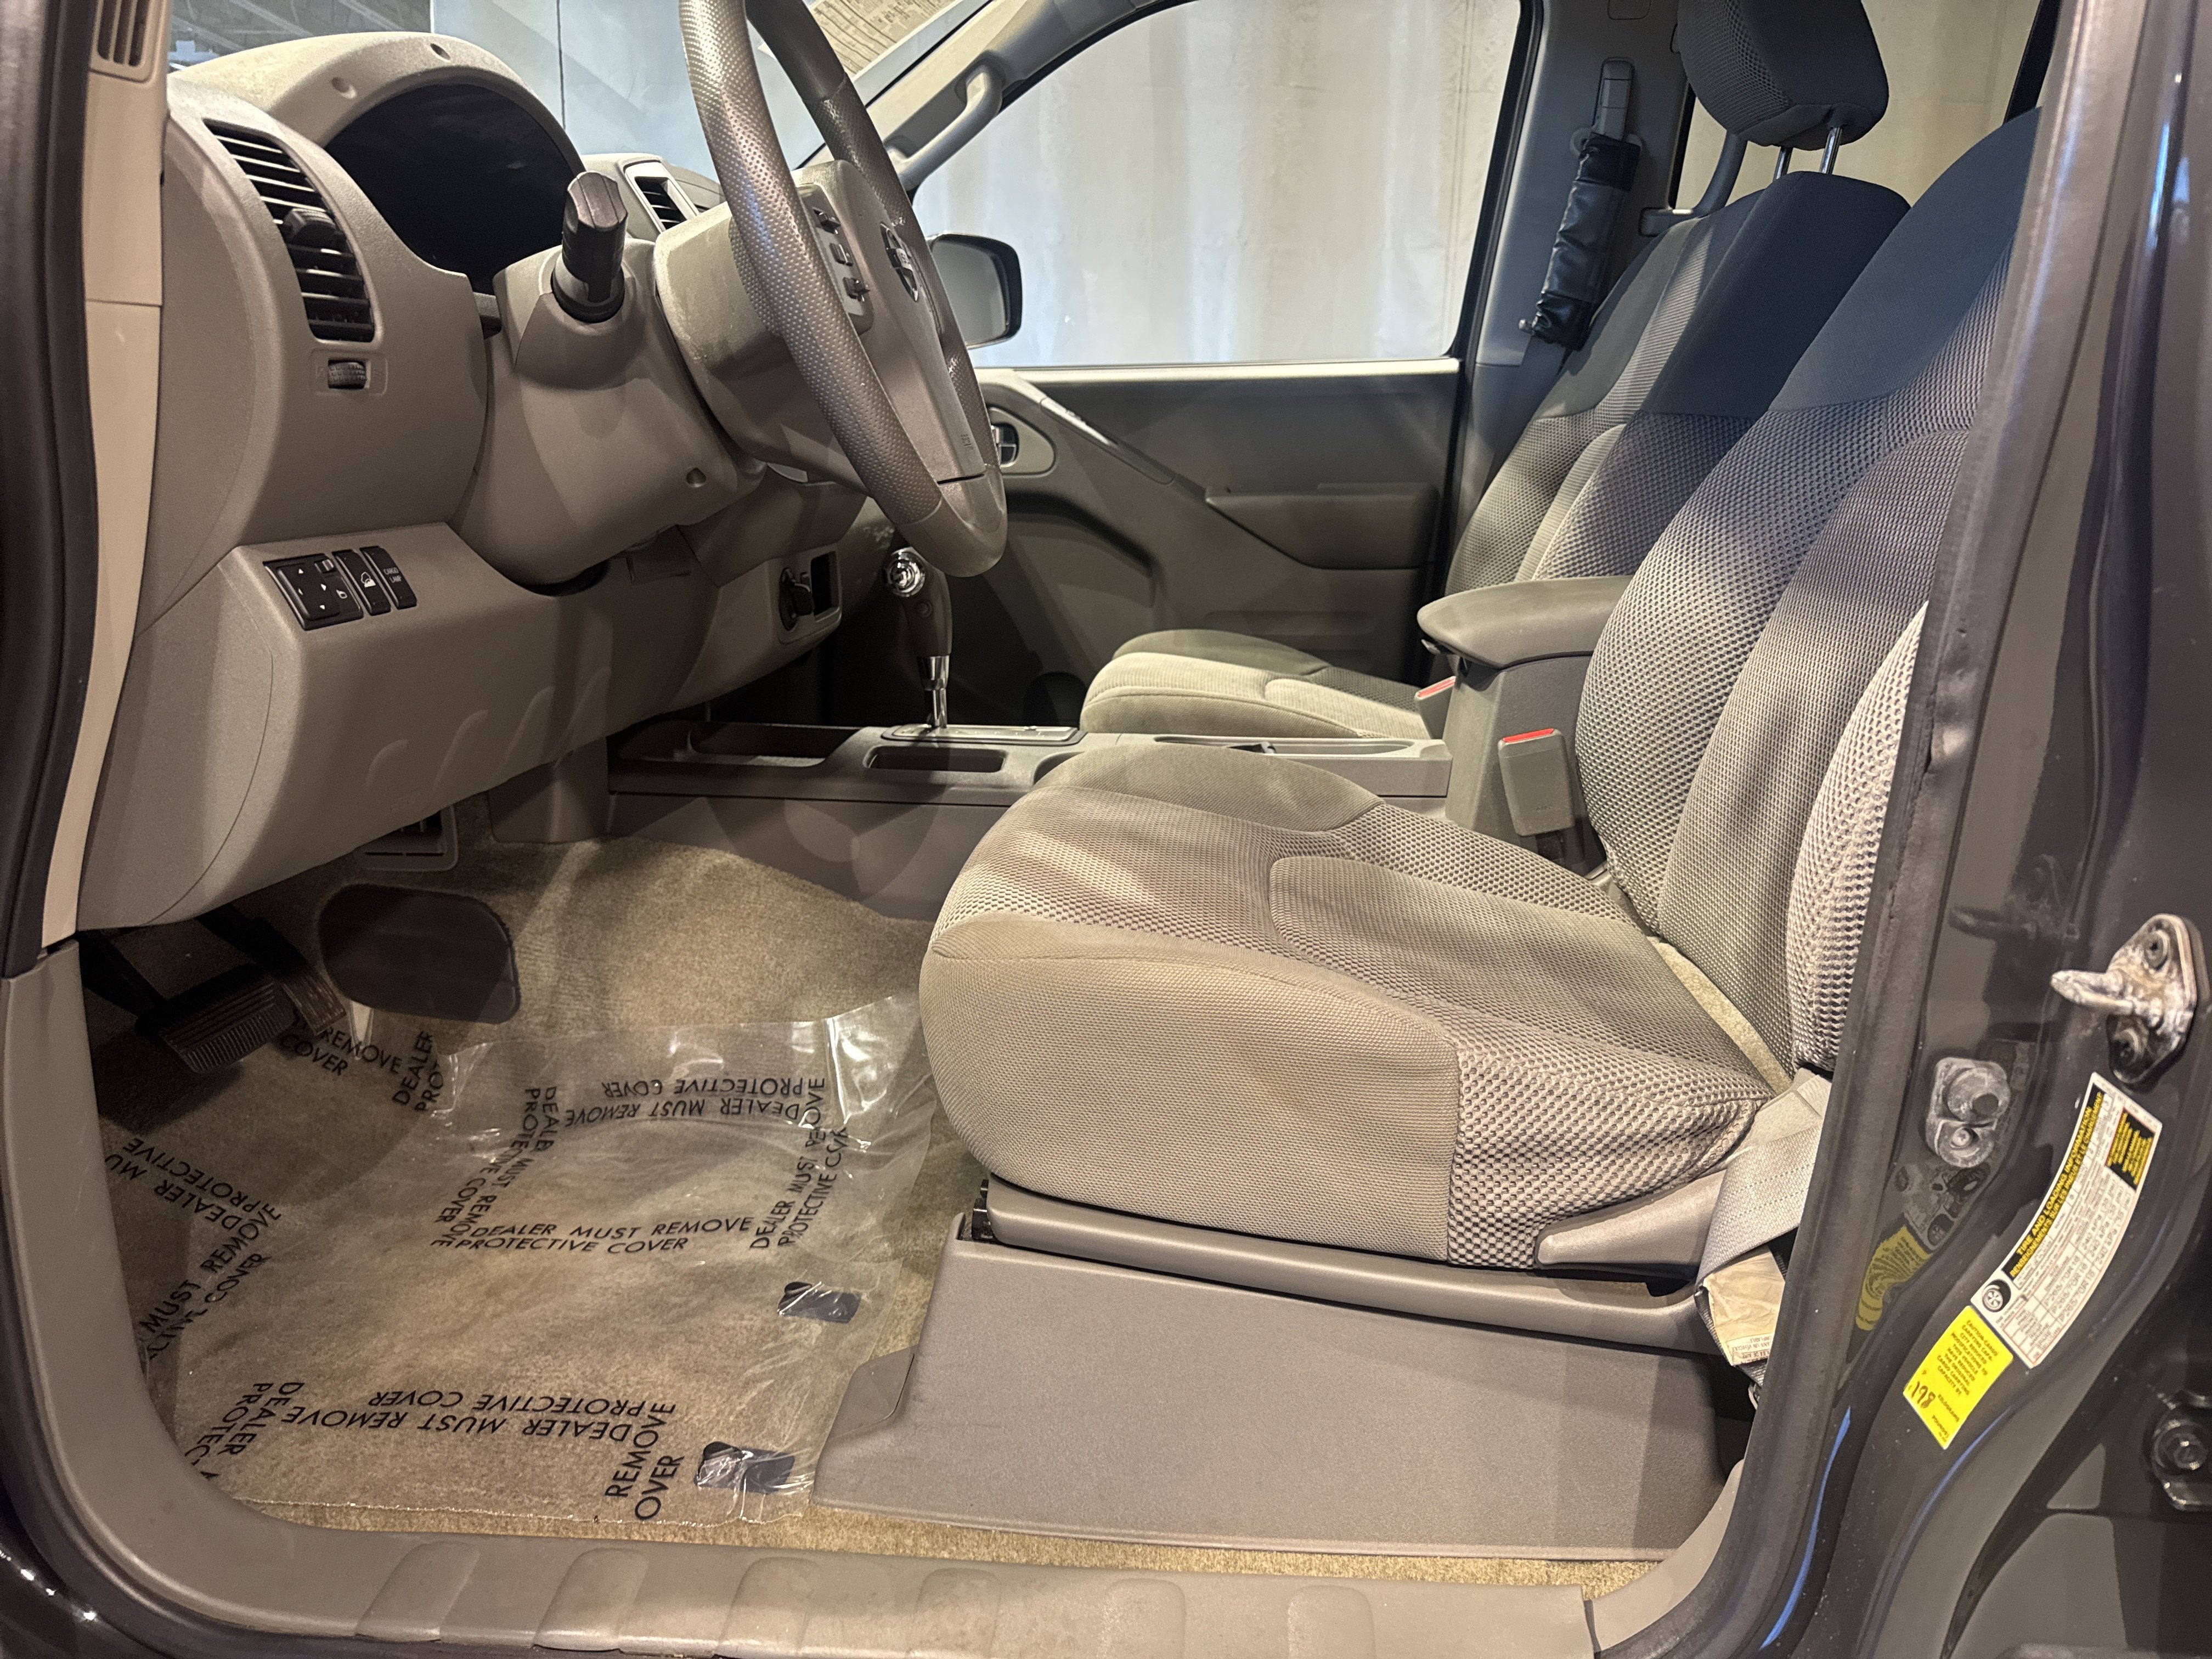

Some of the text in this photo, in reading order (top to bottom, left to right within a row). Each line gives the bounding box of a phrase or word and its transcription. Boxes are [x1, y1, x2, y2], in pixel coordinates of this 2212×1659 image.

[280, 1034, 348, 1075] COVER
[320, 1027, 402, 1074] REMOVE
[565, 1098, 800, 1127] DEALER MUST REMOVE
[603, 1077, 803, 1098] PROTECTIVE COVER
[122, 1138, 261, 1212] PROTECTIVE
[492, 1158, 534, 1188] MUST
[750, 1199, 793, 1250] DEALER
[805, 1078, 826, 1148] REOVE
[2009, 1091, 2103, 1277] RENSEIGNEMENTS SUR LES PNEUS ET LE CHARGEMENT
[2016, 1234, 2034, 1255] TIRE
[2029, 1214, 2046, 1236] AND
[2042, 1172, 2068, 1215] LOADING
[2063, 1105, 2092, 1173] INFORMATION
[154, 1180, 242, 1230] DEALER
[430, 1195, 498, 1247] REMOVE
[434, 1178, 486, 1223] COVER
[777, 1173, 837, 1247] PROTECTIVE
[455, 1237, 689, 1255] PROTECTIVE COVER
[470, 1216, 754, 1240] DEALER MUST REMOVE
[138, 1203, 281, 1334] MUST REMOVE
[204, 1253, 272, 1303] COVER
[217, 1382, 305, 1455] DEALER
[368, 1389, 646, 1416] PROTECTIVE COVER
[1911, 1380, 1936, 1409] 198
[282, 1406, 632, 1442] DEALER MUST REMOVE
[605, 1403, 676, 1498] REMOVE
[635, 1455, 685, 1520] OVER
